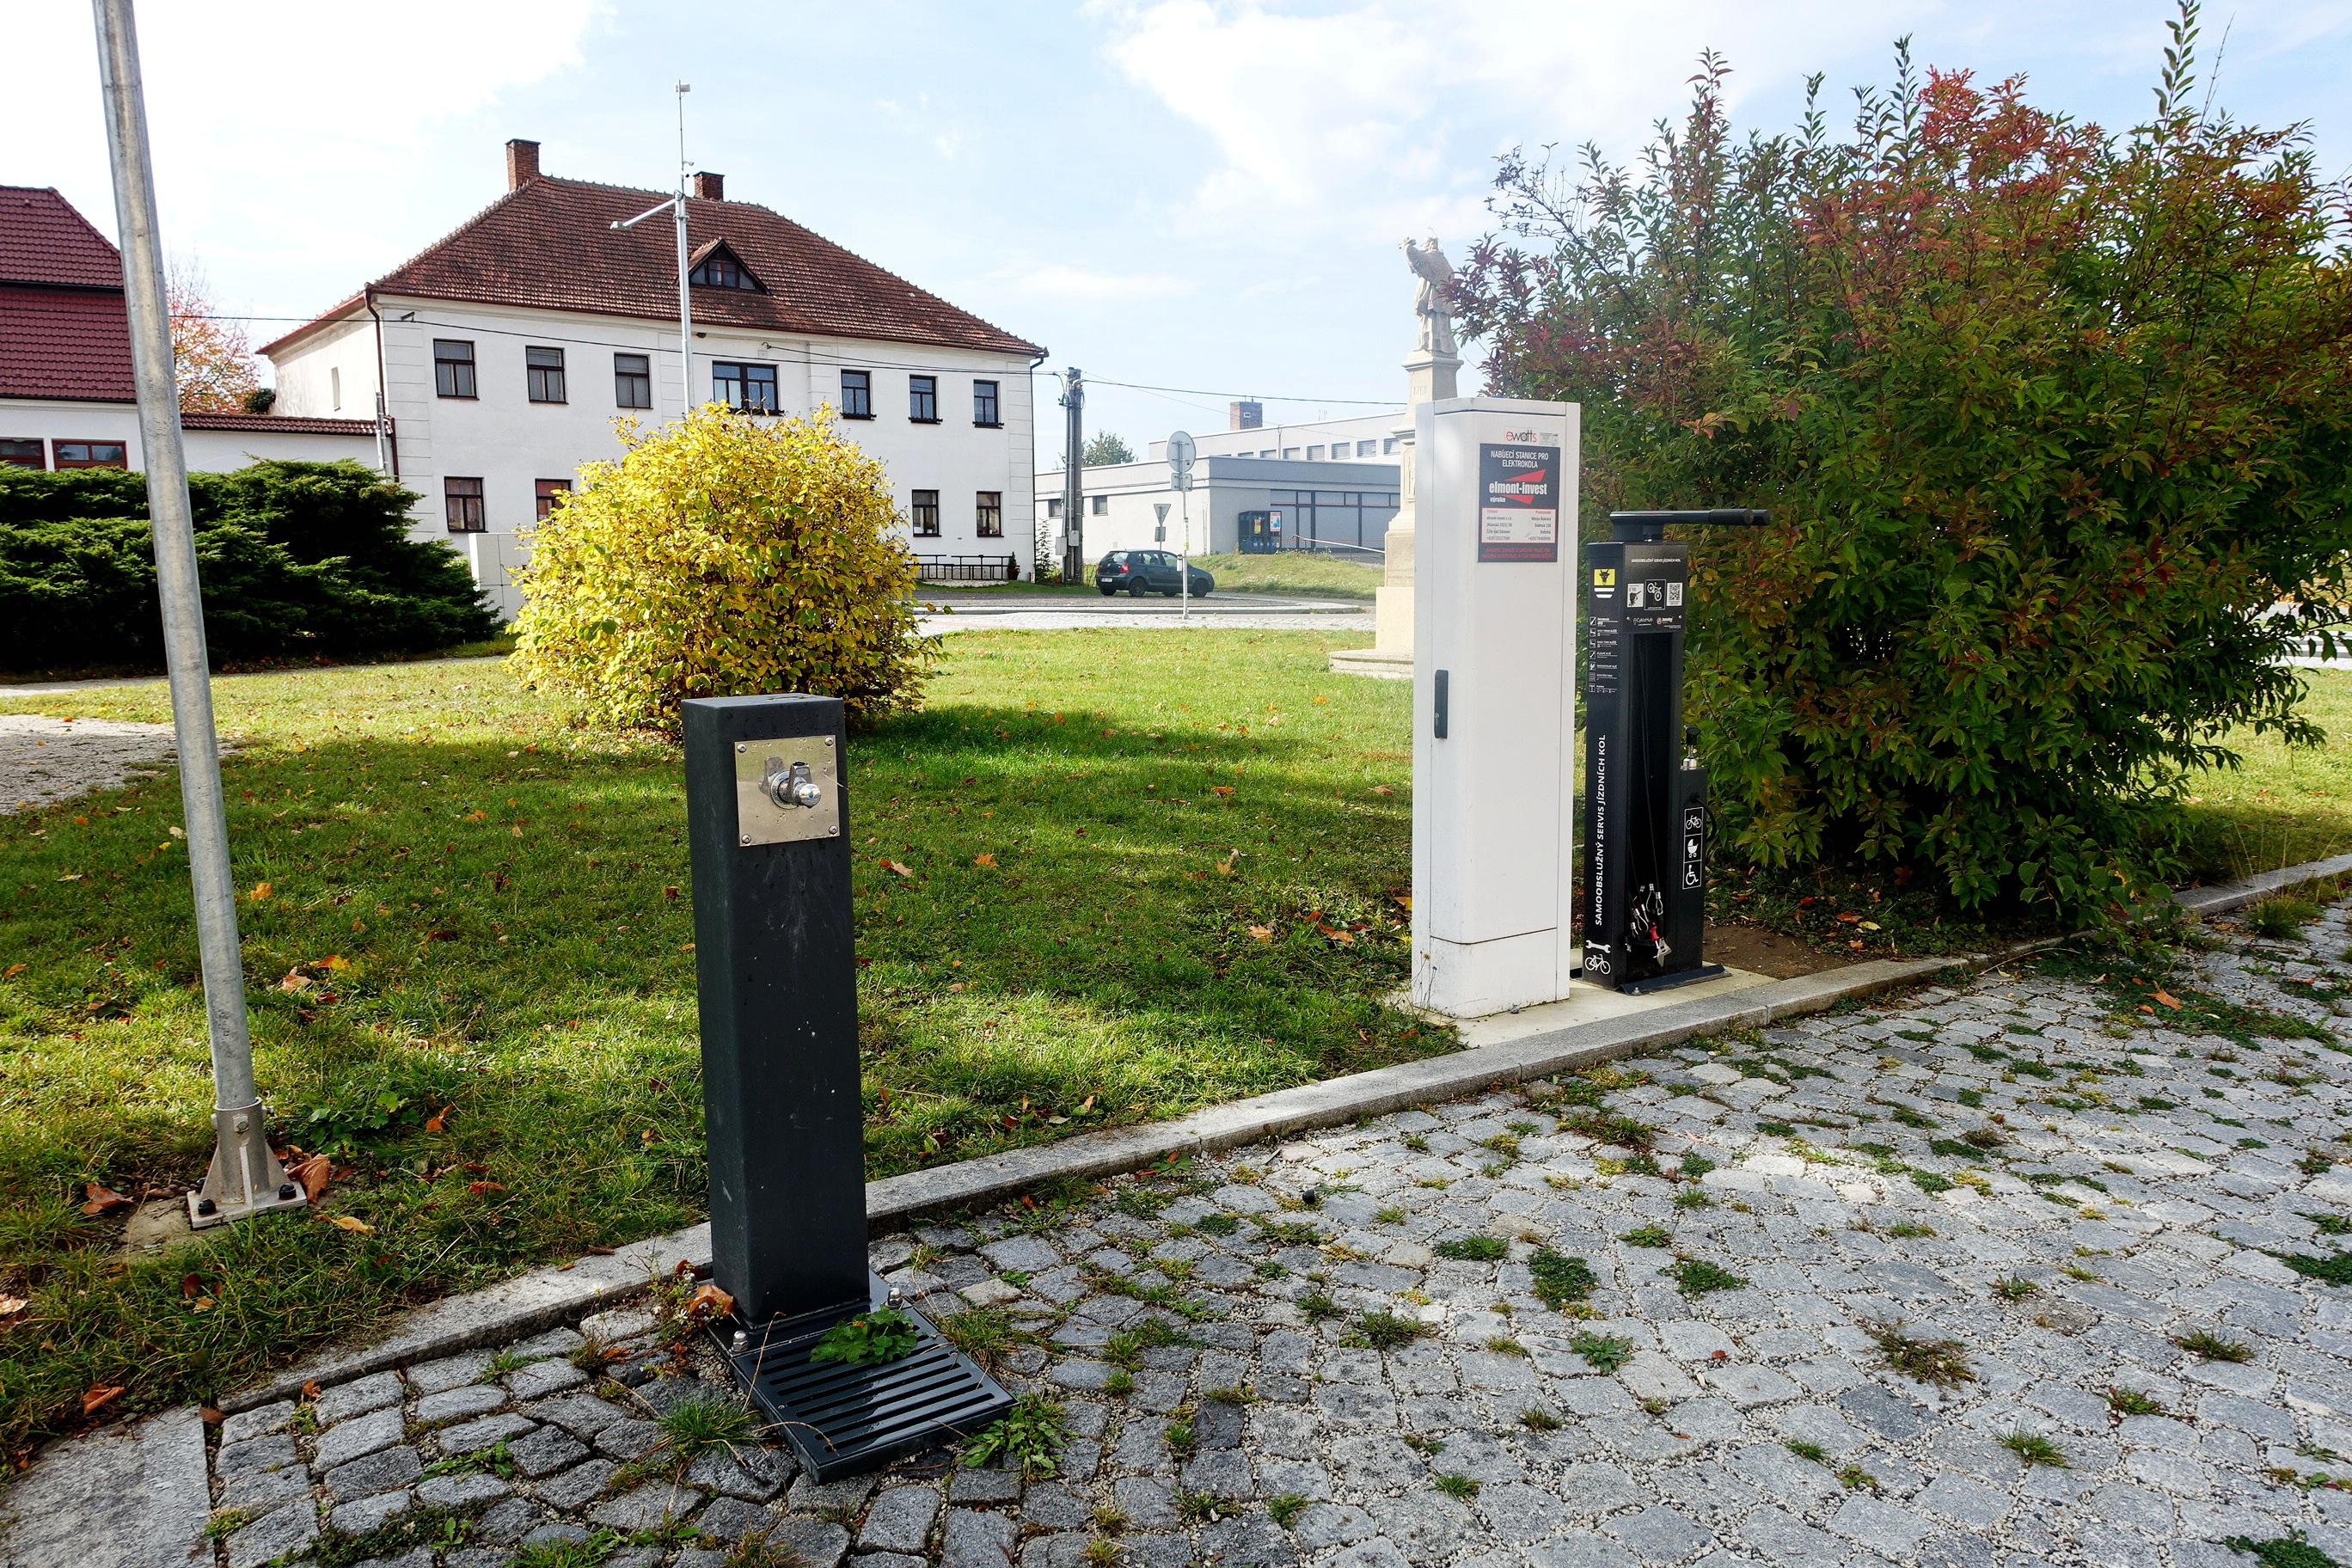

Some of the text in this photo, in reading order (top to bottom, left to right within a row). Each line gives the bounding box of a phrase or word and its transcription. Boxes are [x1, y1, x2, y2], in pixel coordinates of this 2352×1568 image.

[1506, 429, 1537, 443] ewatts
[1491, 449, 1549, 461] NABÍJECÍ STANICE PRO
[1502, 459, 1539, 469] ELEKTROKOLA
[1489, 481, 1547, 495] elmont-invest
[1596, 758, 1606, 805] JÍZDNÍCH
[1596, 806, 1605, 840] SERVIS
[1595, 842, 1604, 926] SAMOOBSLUŽNÝ
